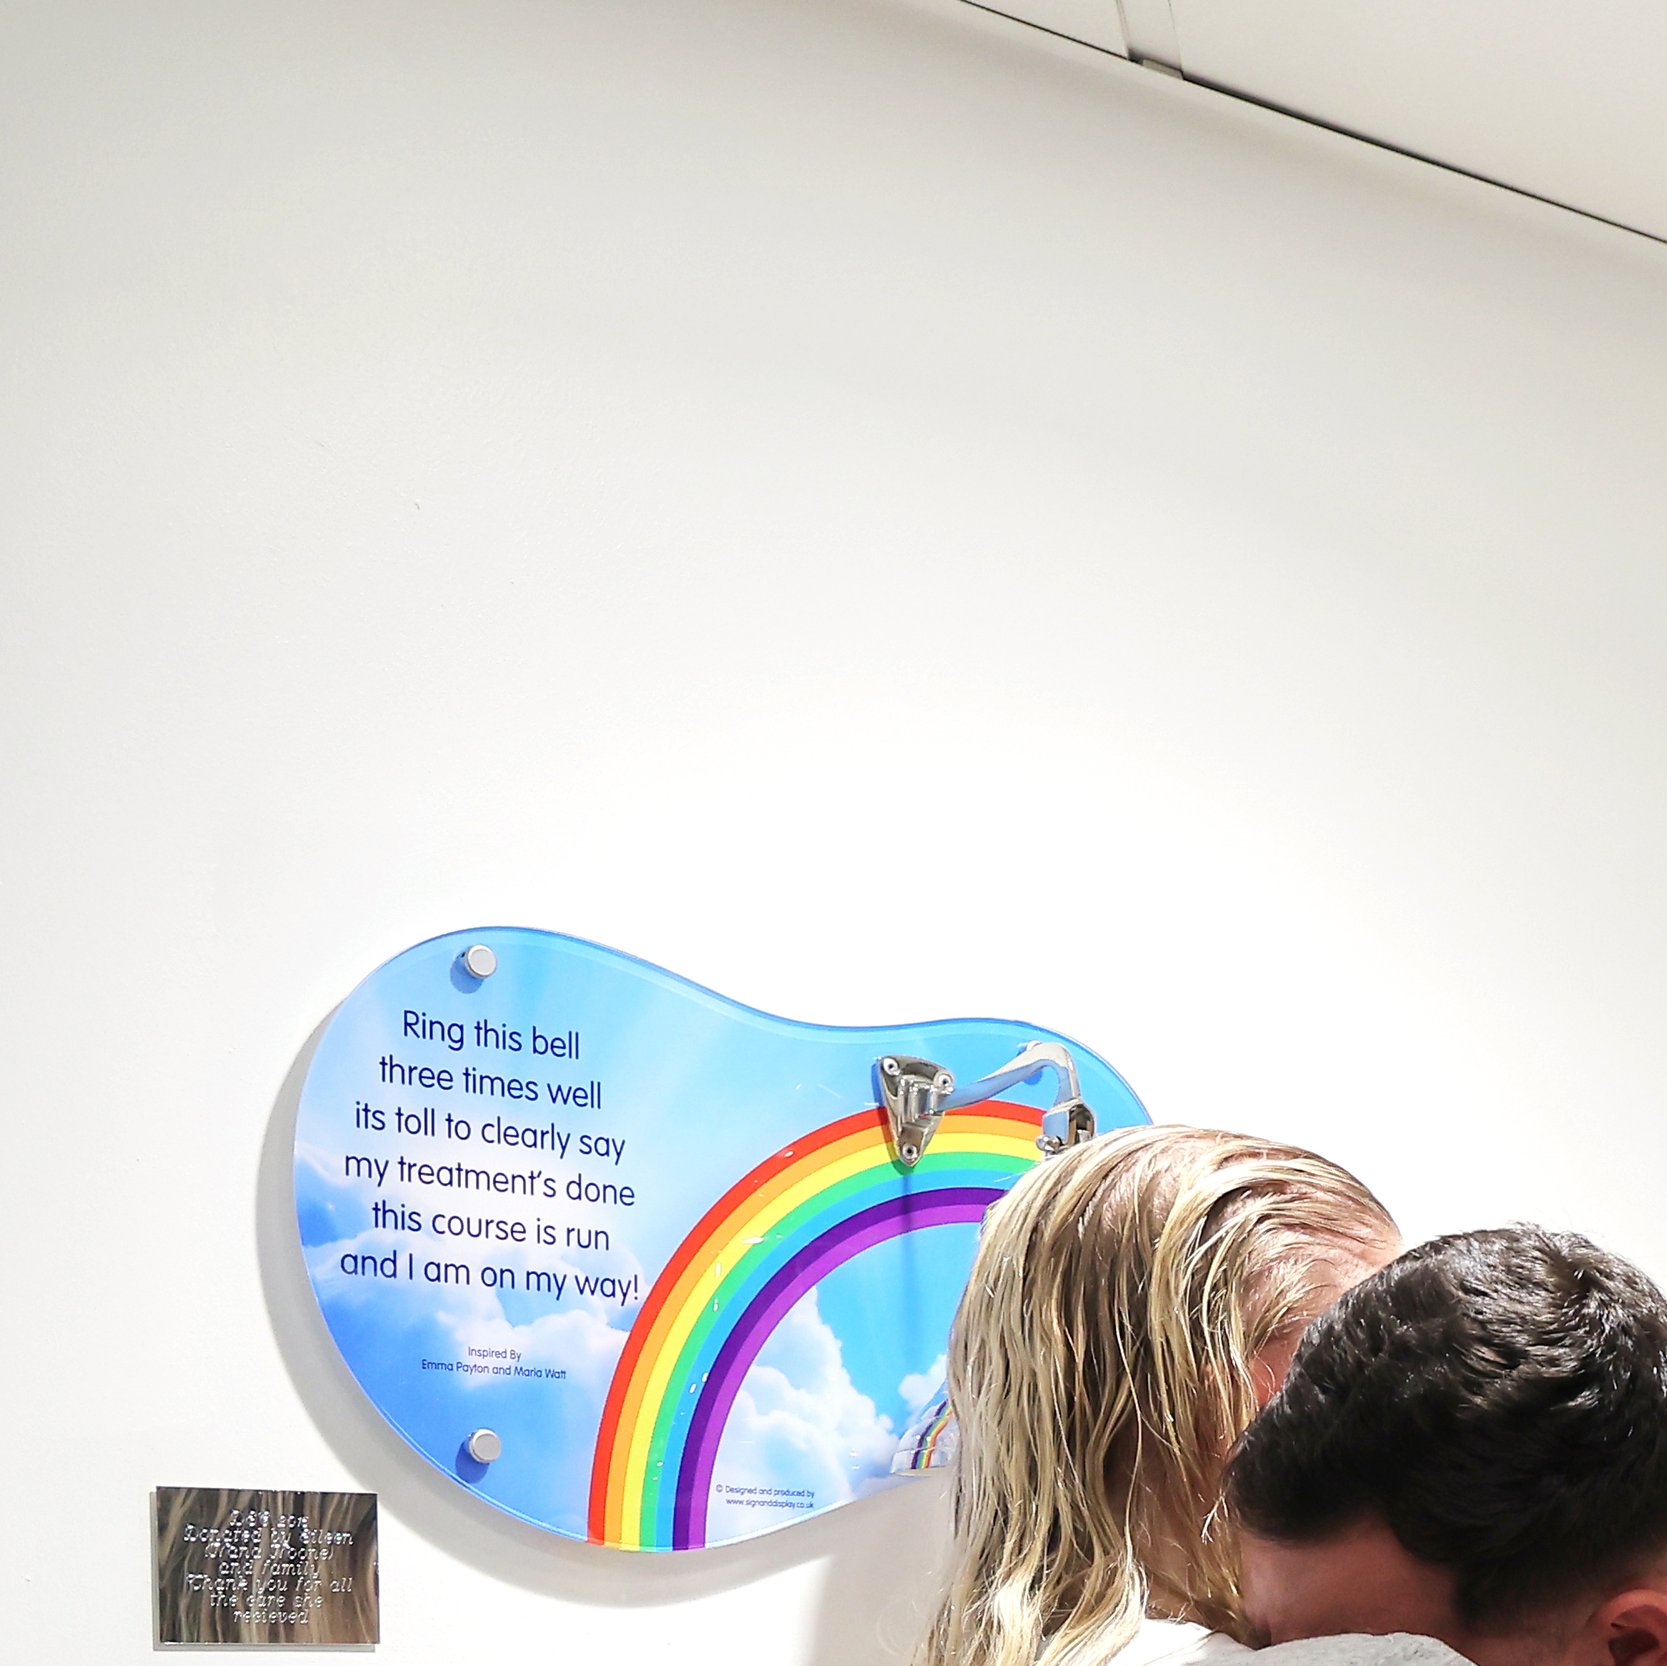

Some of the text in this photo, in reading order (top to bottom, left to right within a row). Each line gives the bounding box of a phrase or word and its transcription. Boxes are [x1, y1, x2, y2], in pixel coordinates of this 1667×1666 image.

[403, 1009, 580, 1060] Ring this bell
[378, 1054, 602, 1110] three times well
[355, 1100, 626, 1166] its toll to clearly say
[345, 1155, 636, 1206] my treatment's done
[372, 1200, 610, 1251] this course is run
[340, 1250, 639, 1307] and I am on my way!
[468, 1346, 521, 1362] Inspired By
[421, 1359, 566, 1379] Emma Payton and Maria Watt
[725, 1485, 757, 1495] Designed
[774, 1488, 805, 1497] produced
[807, 1490, 815, 1498] by
[184, 1523, 354, 1545] Donated by Eileen
[219, 1559, 321, 1579] and family
[186, 1574, 353, 1594] Thank you for all
[210, 1591, 238, 1607] the
